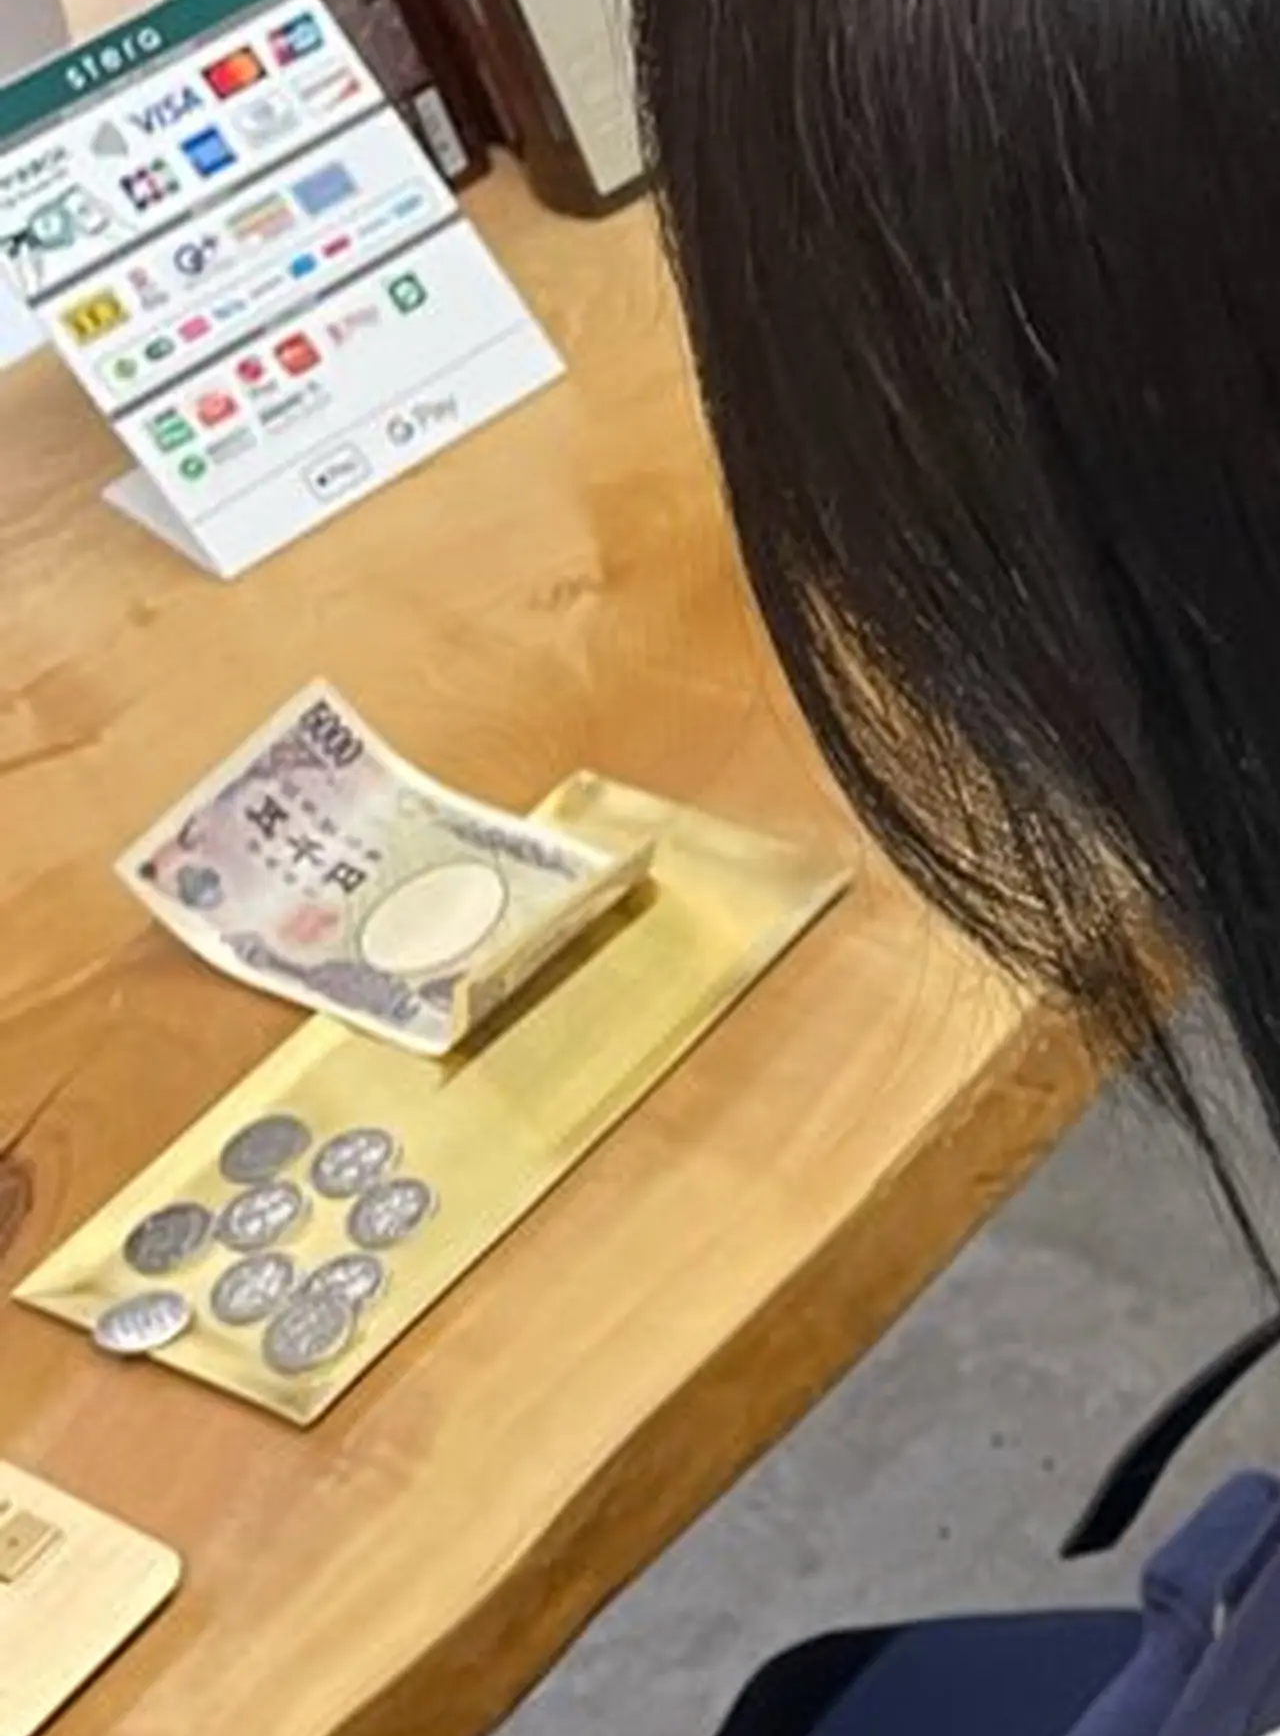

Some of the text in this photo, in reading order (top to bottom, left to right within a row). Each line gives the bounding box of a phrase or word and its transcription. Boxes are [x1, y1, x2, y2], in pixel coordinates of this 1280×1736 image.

[65, 26, 163, 91] stera
[129, 85, 204, 134] VISA
[299, 700, 365, 768] 5000
[244, 794, 367, 895] 五千円
